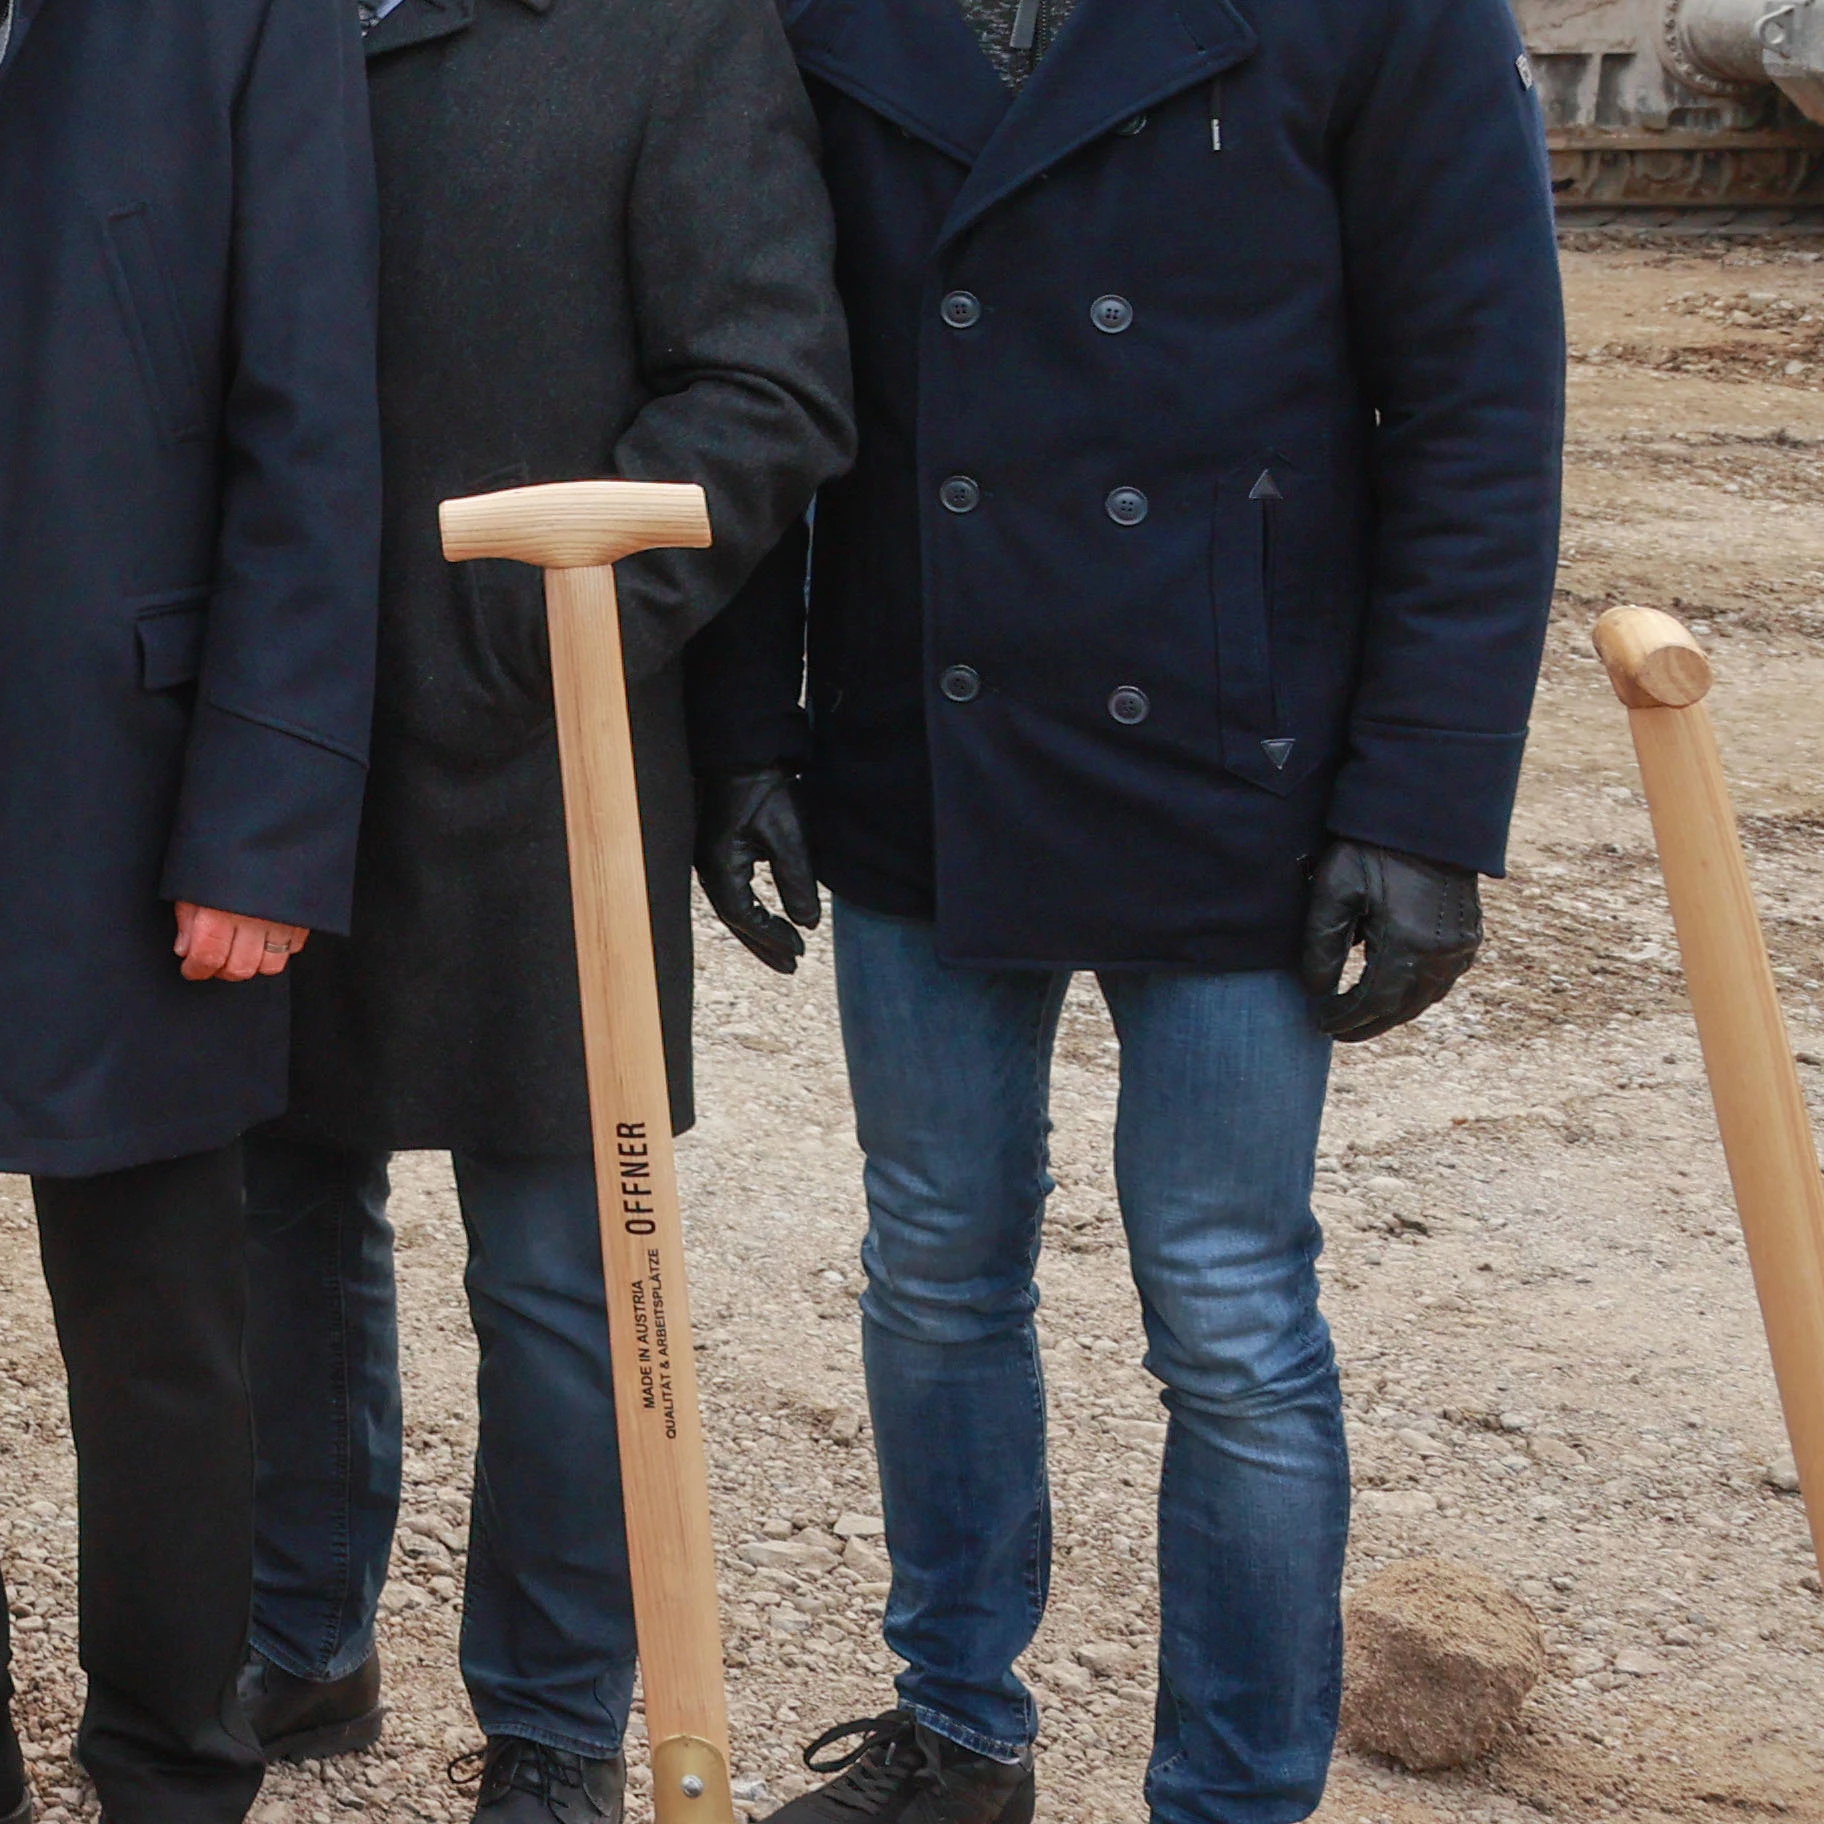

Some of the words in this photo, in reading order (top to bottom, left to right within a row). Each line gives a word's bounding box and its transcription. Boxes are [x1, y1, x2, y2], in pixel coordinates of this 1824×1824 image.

[616, 1121, 656, 1236] OFFNER
[631, 1279, 649, 1345] AUSTRIA
[638, 1347, 650, 1363] IN
[657, 1359, 671, 1370] &
[640, 1367, 654, 1408] MADE
